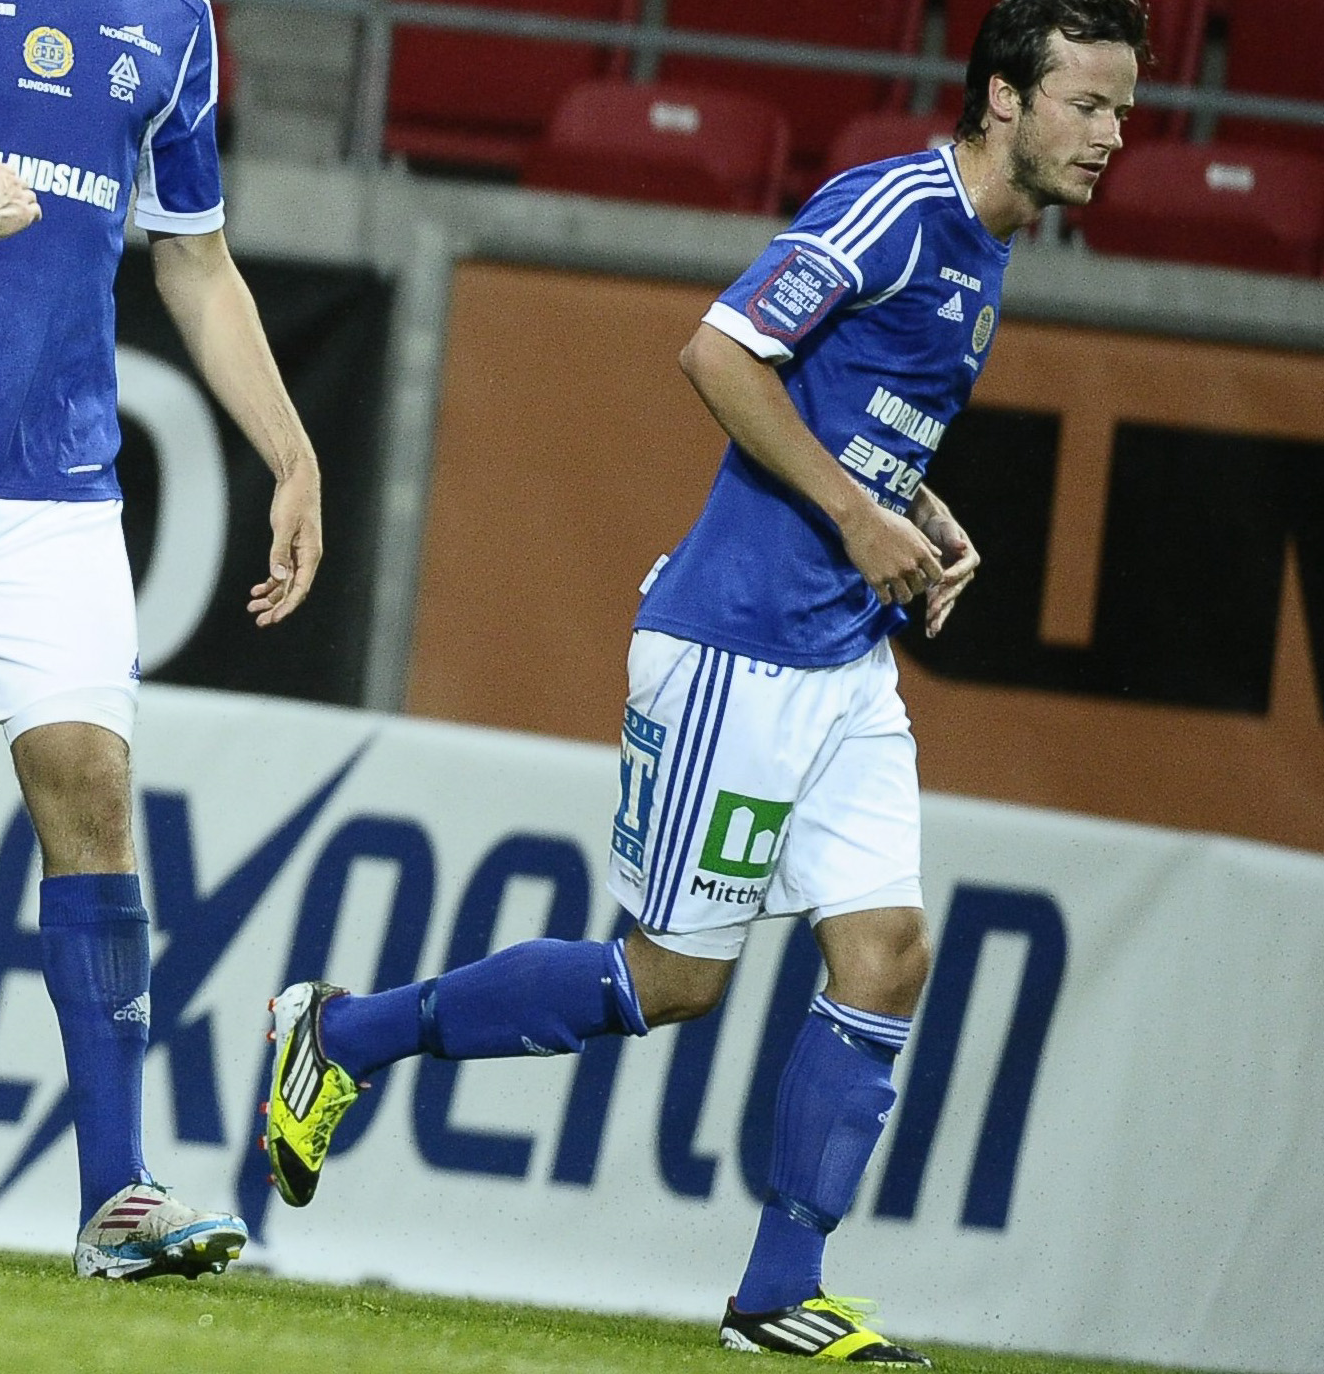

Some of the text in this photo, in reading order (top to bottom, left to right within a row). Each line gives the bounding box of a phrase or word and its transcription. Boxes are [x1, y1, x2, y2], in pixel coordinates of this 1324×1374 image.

[17, 77, 73, 98] SUNDSVALL
[109, 84, 134, 104] SCA
[797, 268, 822, 290] HELA
[623, 709, 663, 743] EDIE
[689, 874, 767, 905] Mitth
